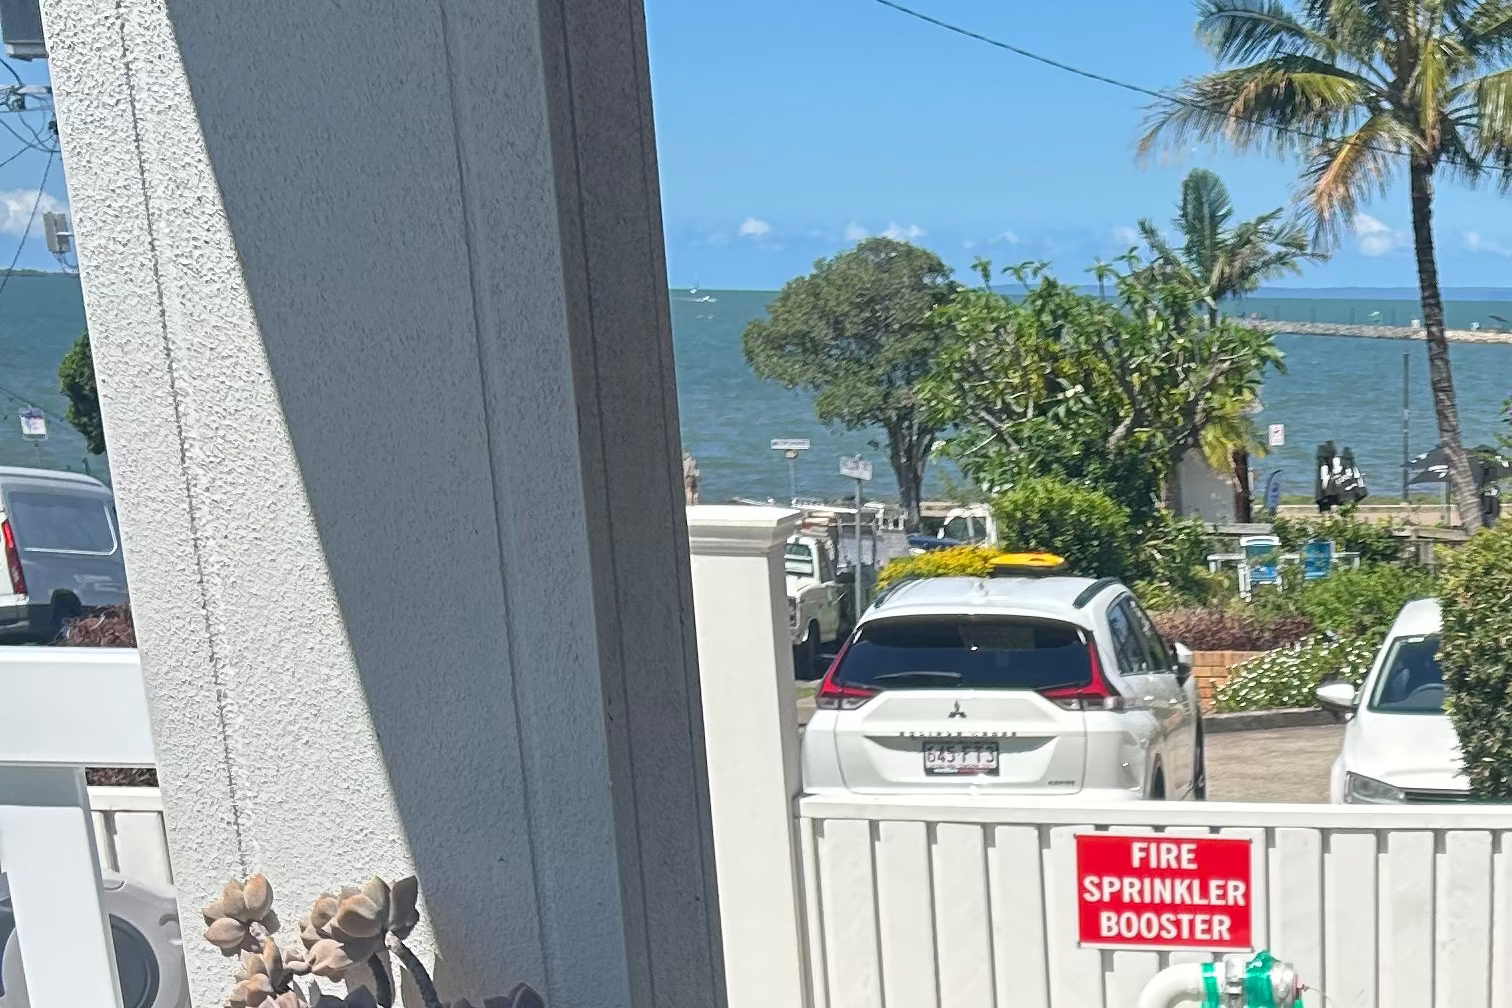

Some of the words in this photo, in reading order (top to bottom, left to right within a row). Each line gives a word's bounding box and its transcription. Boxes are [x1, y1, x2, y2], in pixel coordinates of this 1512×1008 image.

[1131, 841, 1199, 870] FIRE
[1082, 875, 1247, 907] SPRINKLER
[1099, 910, 1232, 941] BOOSTER
